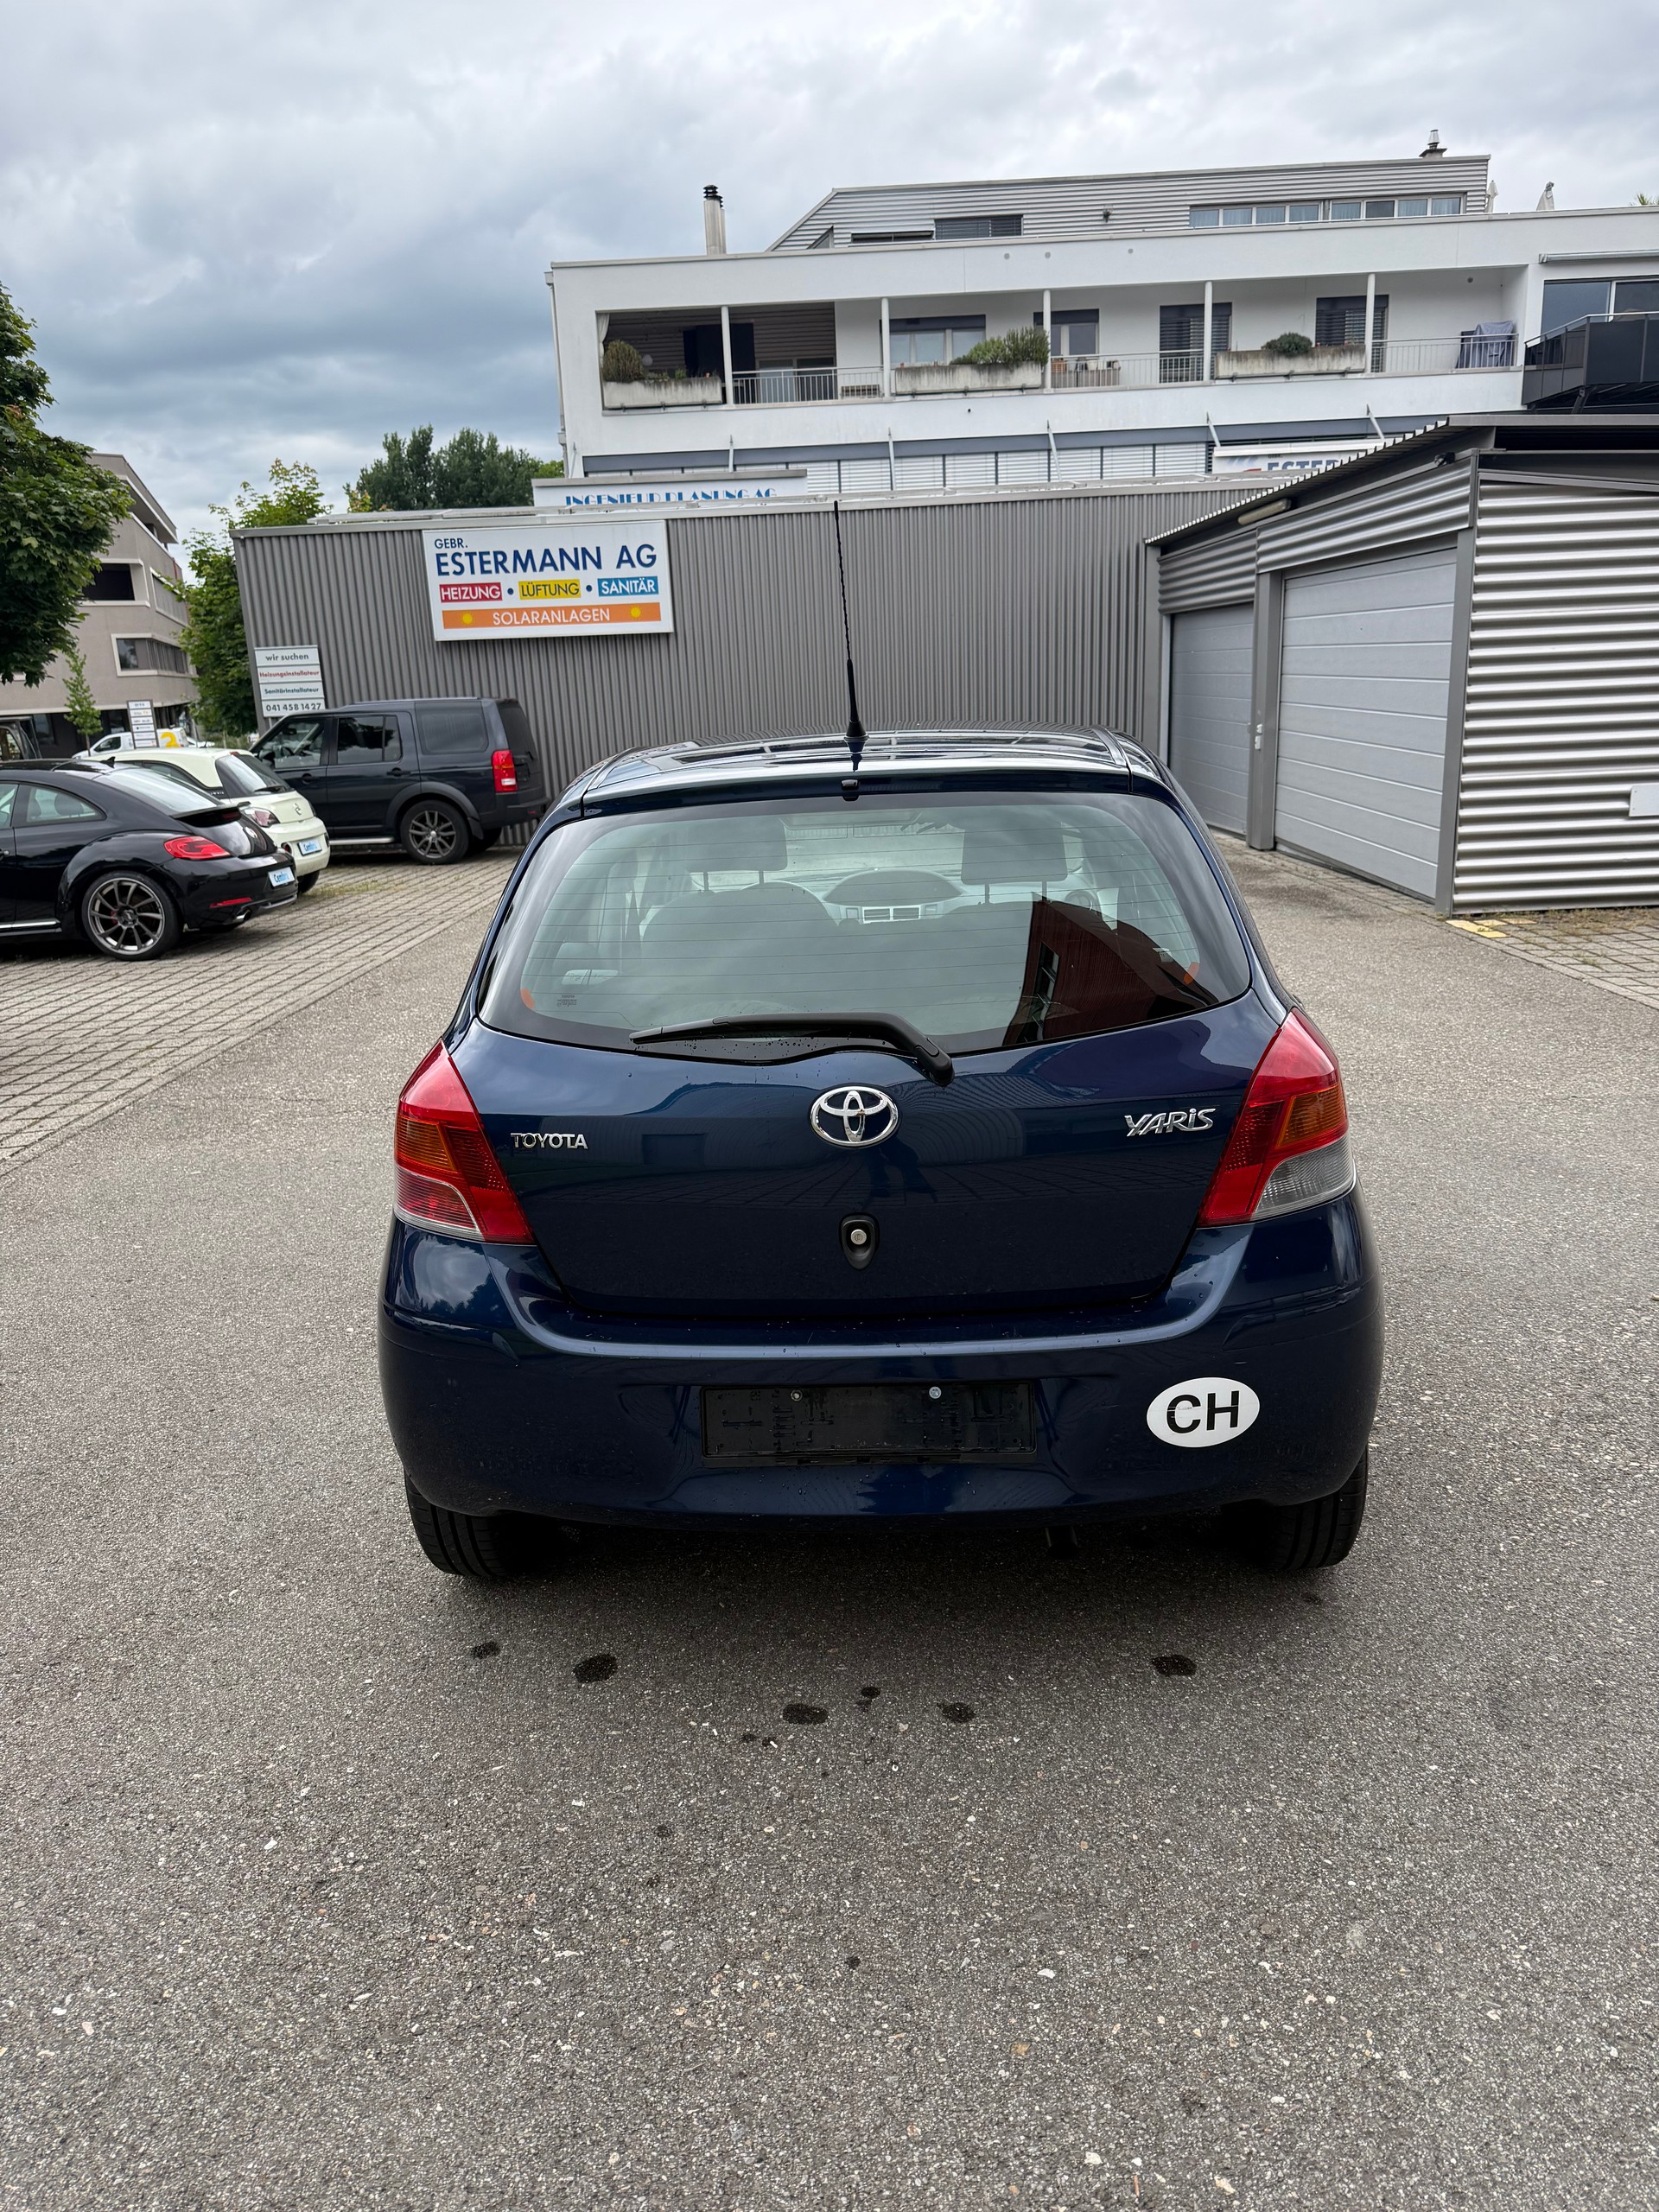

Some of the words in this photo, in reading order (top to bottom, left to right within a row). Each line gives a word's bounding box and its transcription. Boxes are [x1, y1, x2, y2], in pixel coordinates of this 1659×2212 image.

[434, 537, 468, 549] GEBR.
[435, 546, 602, 576] ESTERMANN
[615, 543, 657, 569] AG
[441, 584, 501, 601] HEIZUNG
[521, 582, 580, 597] LÜFTUNG
[601, 578, 656, 594] SANITÄR
[493, 608, 610, 626] SOLARANLAGEN
[510, 1133, 588, 1149] TOYOTA
[1166, 1390, 1239, 1433] CH
